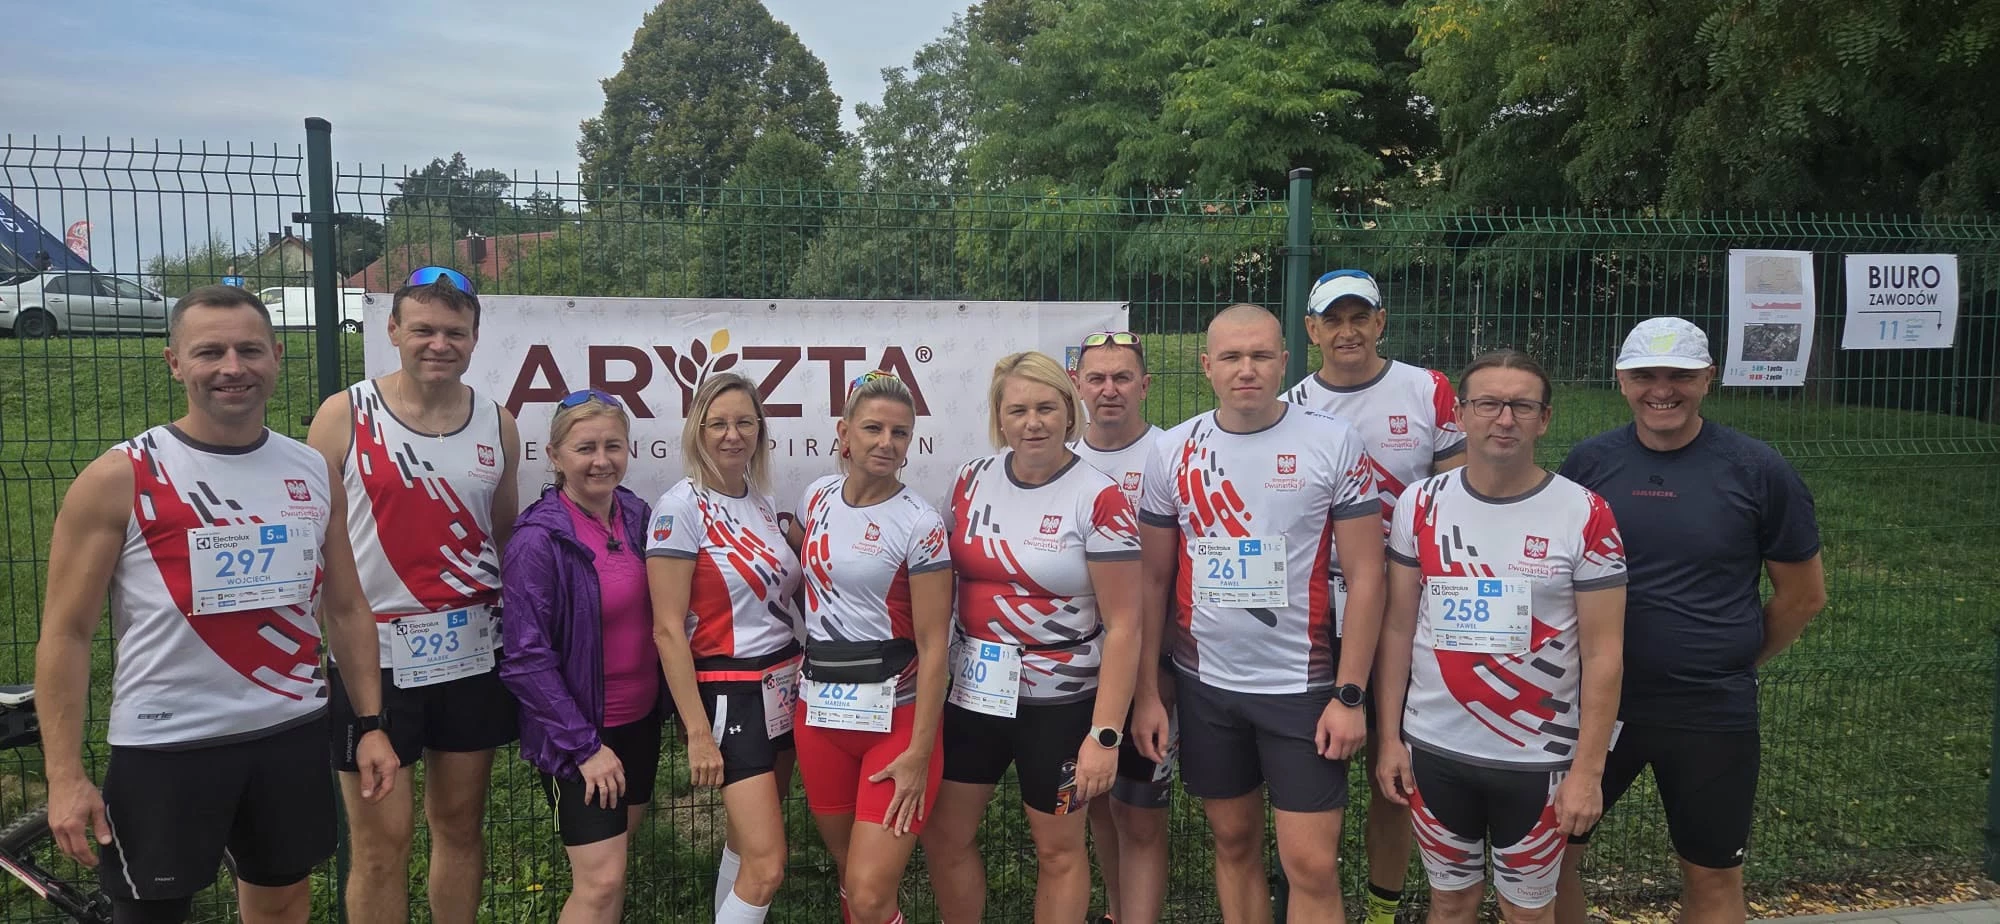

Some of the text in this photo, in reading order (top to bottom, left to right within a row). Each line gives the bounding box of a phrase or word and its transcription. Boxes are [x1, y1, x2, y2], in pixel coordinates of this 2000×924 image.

[1868, 265, 1941, 289] BIURO
[1868, 290, 1938, 306] ZAWODÓW
[1880, 320, 1899, 341] 11
[213, 534, 250, 542] Electrolux
[267, 529, 275, 540] 5
[1244, 543, 1250, 552] 5
[215, 547, 275, 578] 297
[1207, 558, 1247, 580] 261
[227, 576, 271, 585] WOJCIECH
[1483, 583, 1491, 593] 5
[1442, 598, 1490, 622] 258
[452, 614, 458, 624] 5
[411, 630, 460, 658] 293
[984, 647, 990, 656] 5
[961, 657, 987, 683] 260
[818, 682, 858, 700] 262
